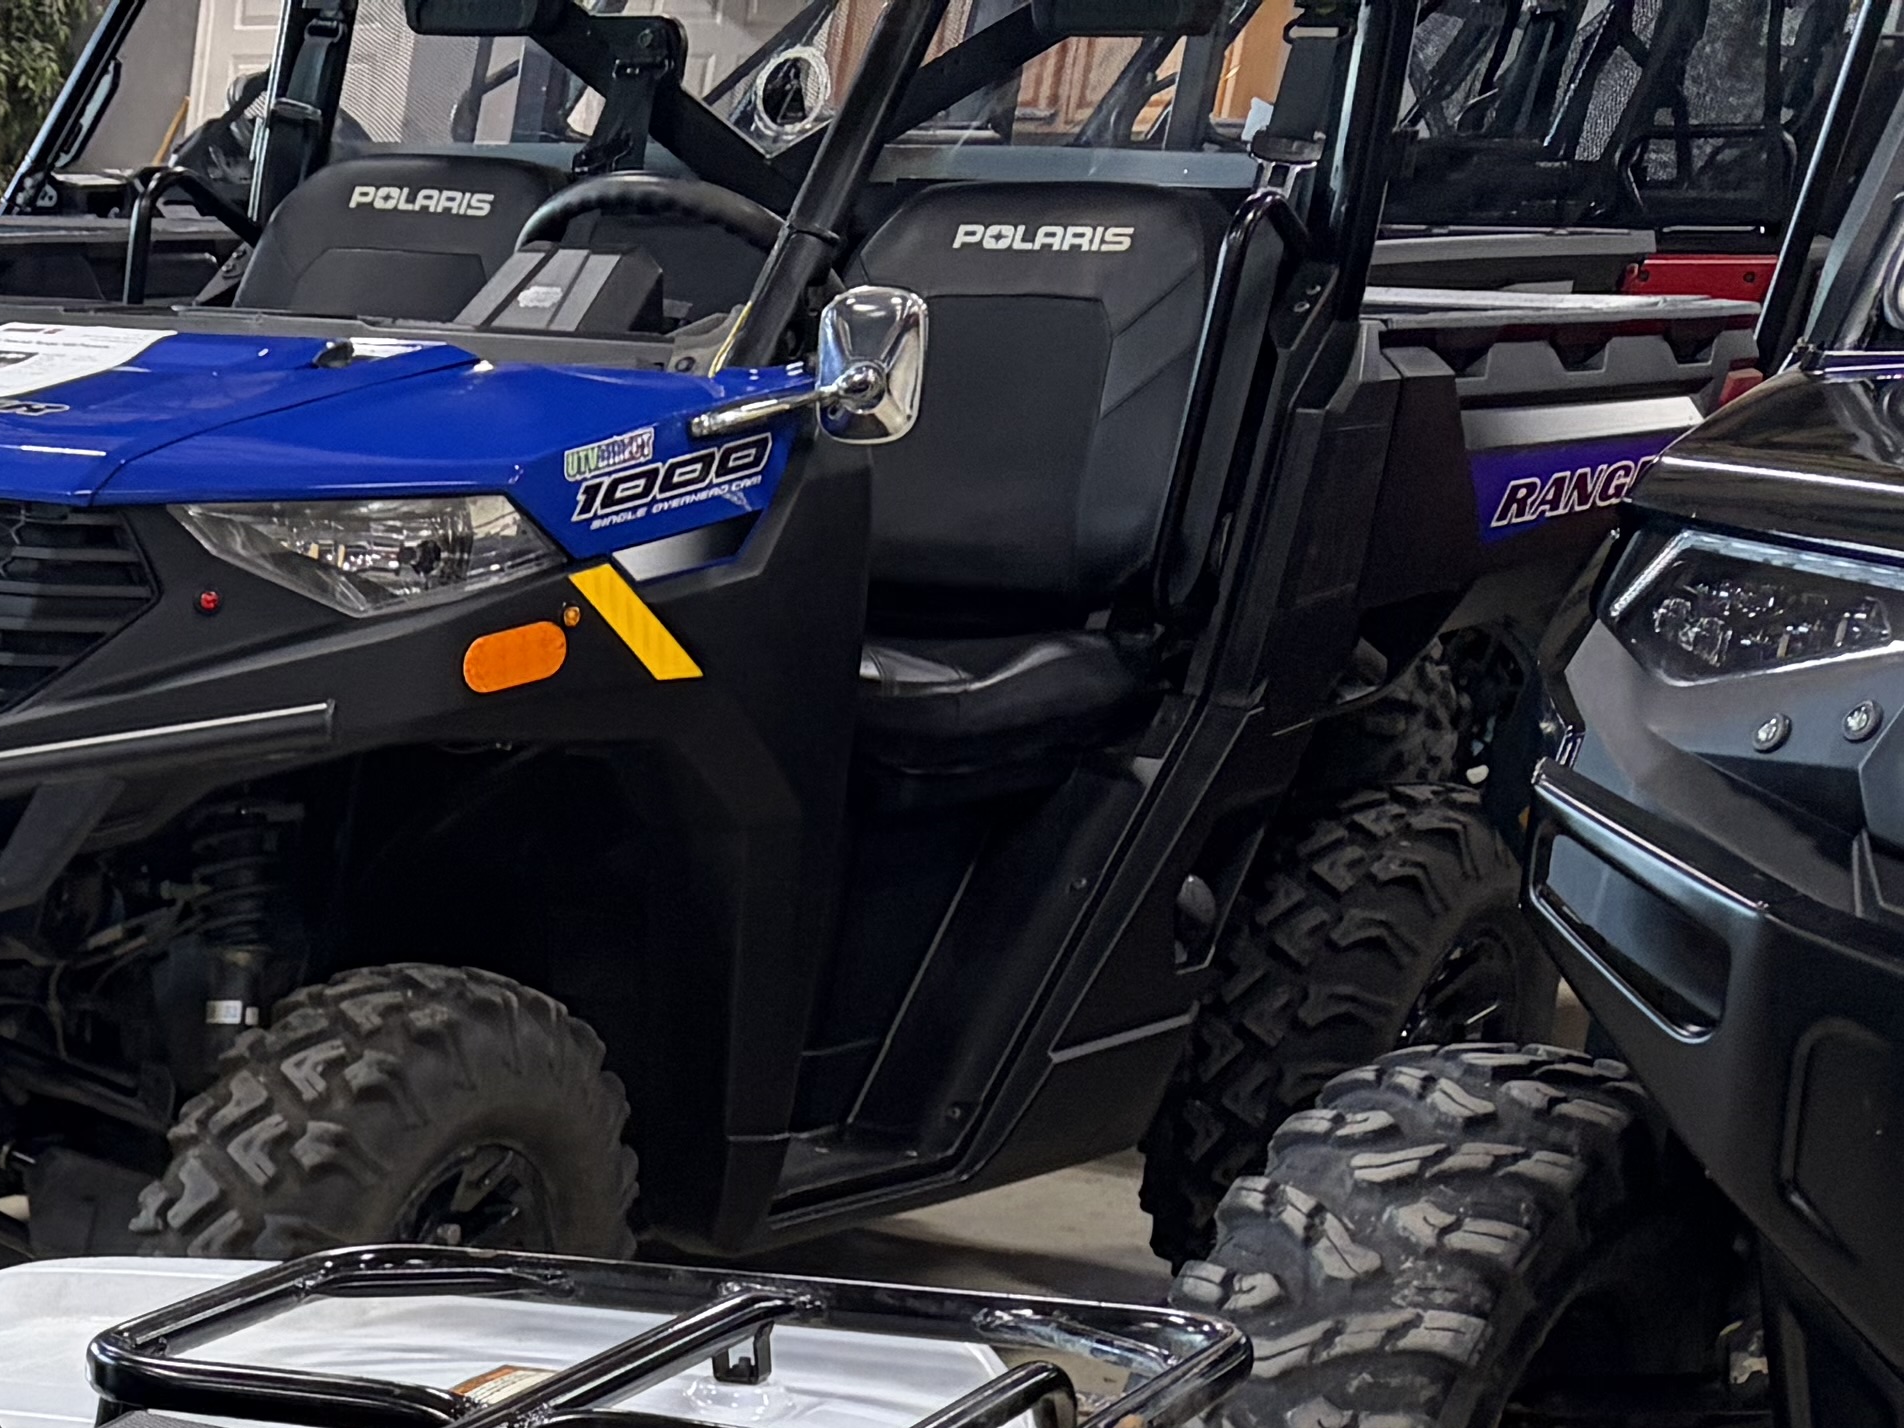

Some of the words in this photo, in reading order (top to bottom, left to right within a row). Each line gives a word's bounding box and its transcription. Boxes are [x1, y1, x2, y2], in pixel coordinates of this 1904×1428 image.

[348, 185, 494, 217] POLARIS
[951, 224, 1135, 252] POLARIS
[571, 432, 773, 522] 1000
[1490, 455, 1659, 528] RANG
[590, 506, 648, 530] SINGLE
